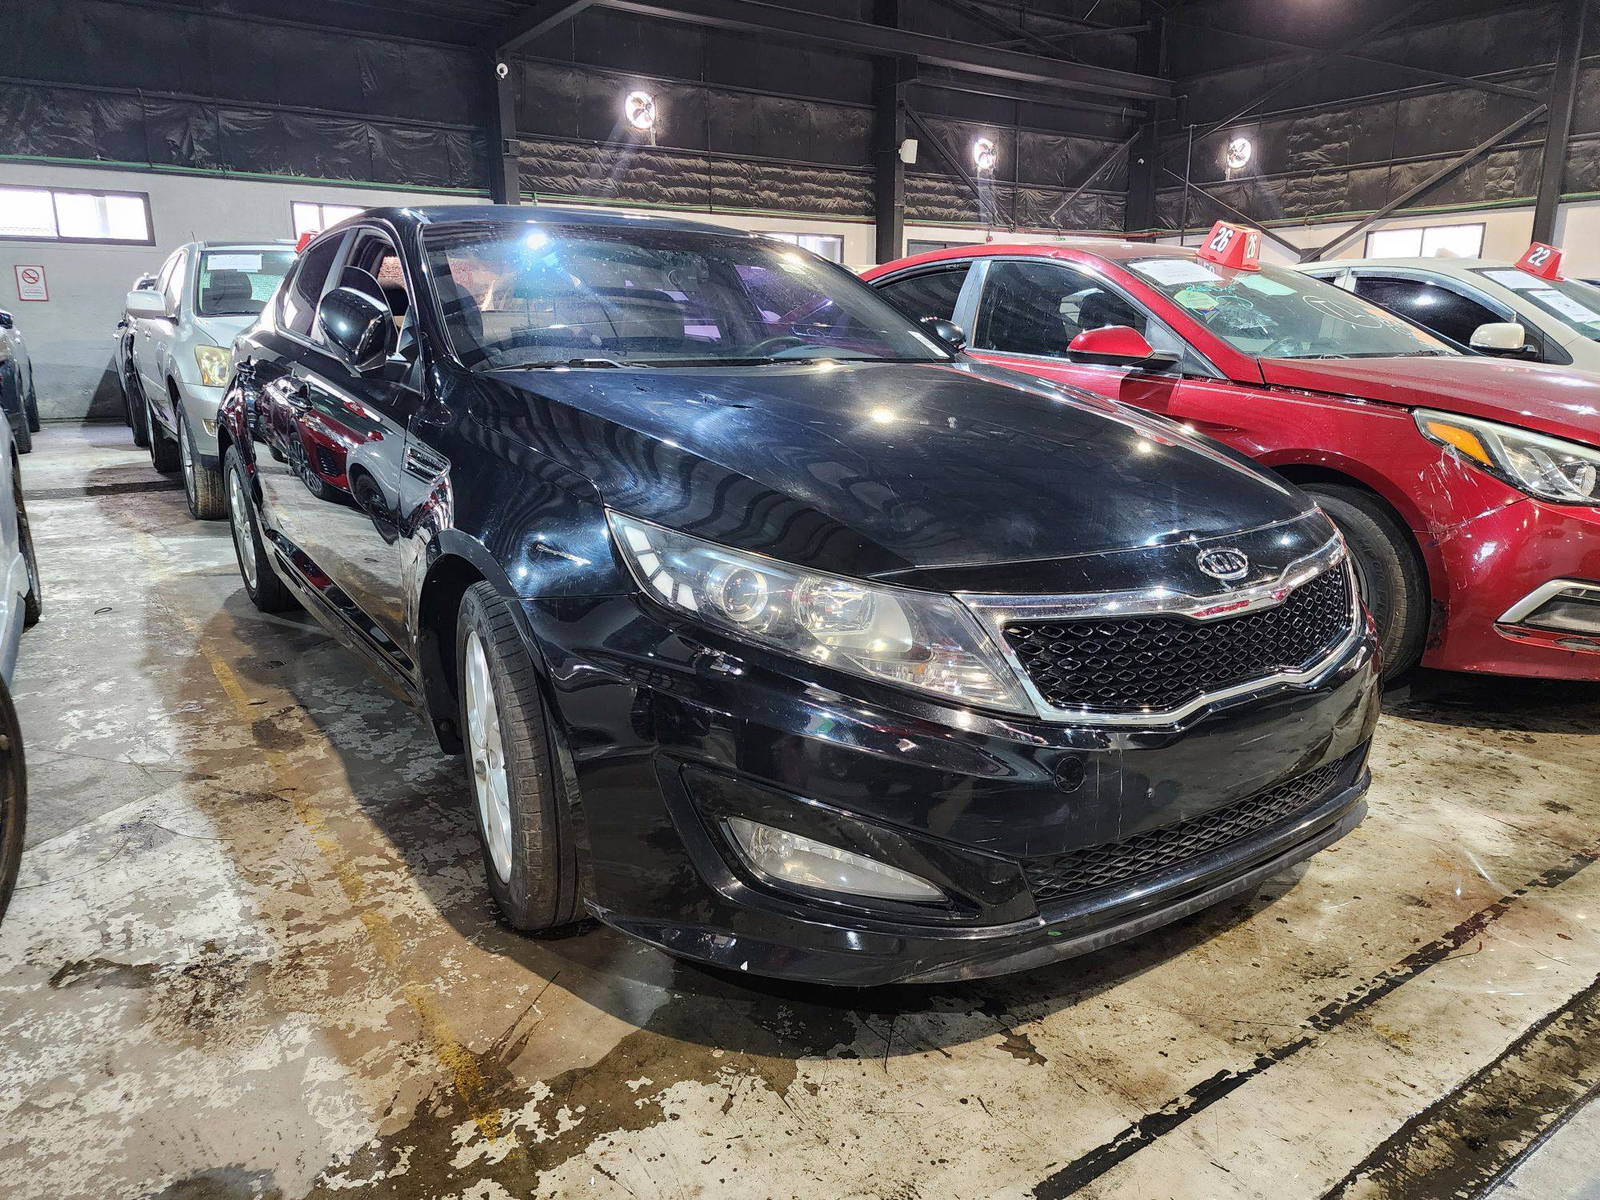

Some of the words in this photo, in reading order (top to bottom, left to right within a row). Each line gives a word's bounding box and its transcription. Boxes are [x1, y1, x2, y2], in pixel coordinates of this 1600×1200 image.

[1209, 226, 1235, 253] 26
[1527, 246, 1551, 267] 22
[1203, 551, 1246, 574] KIA
